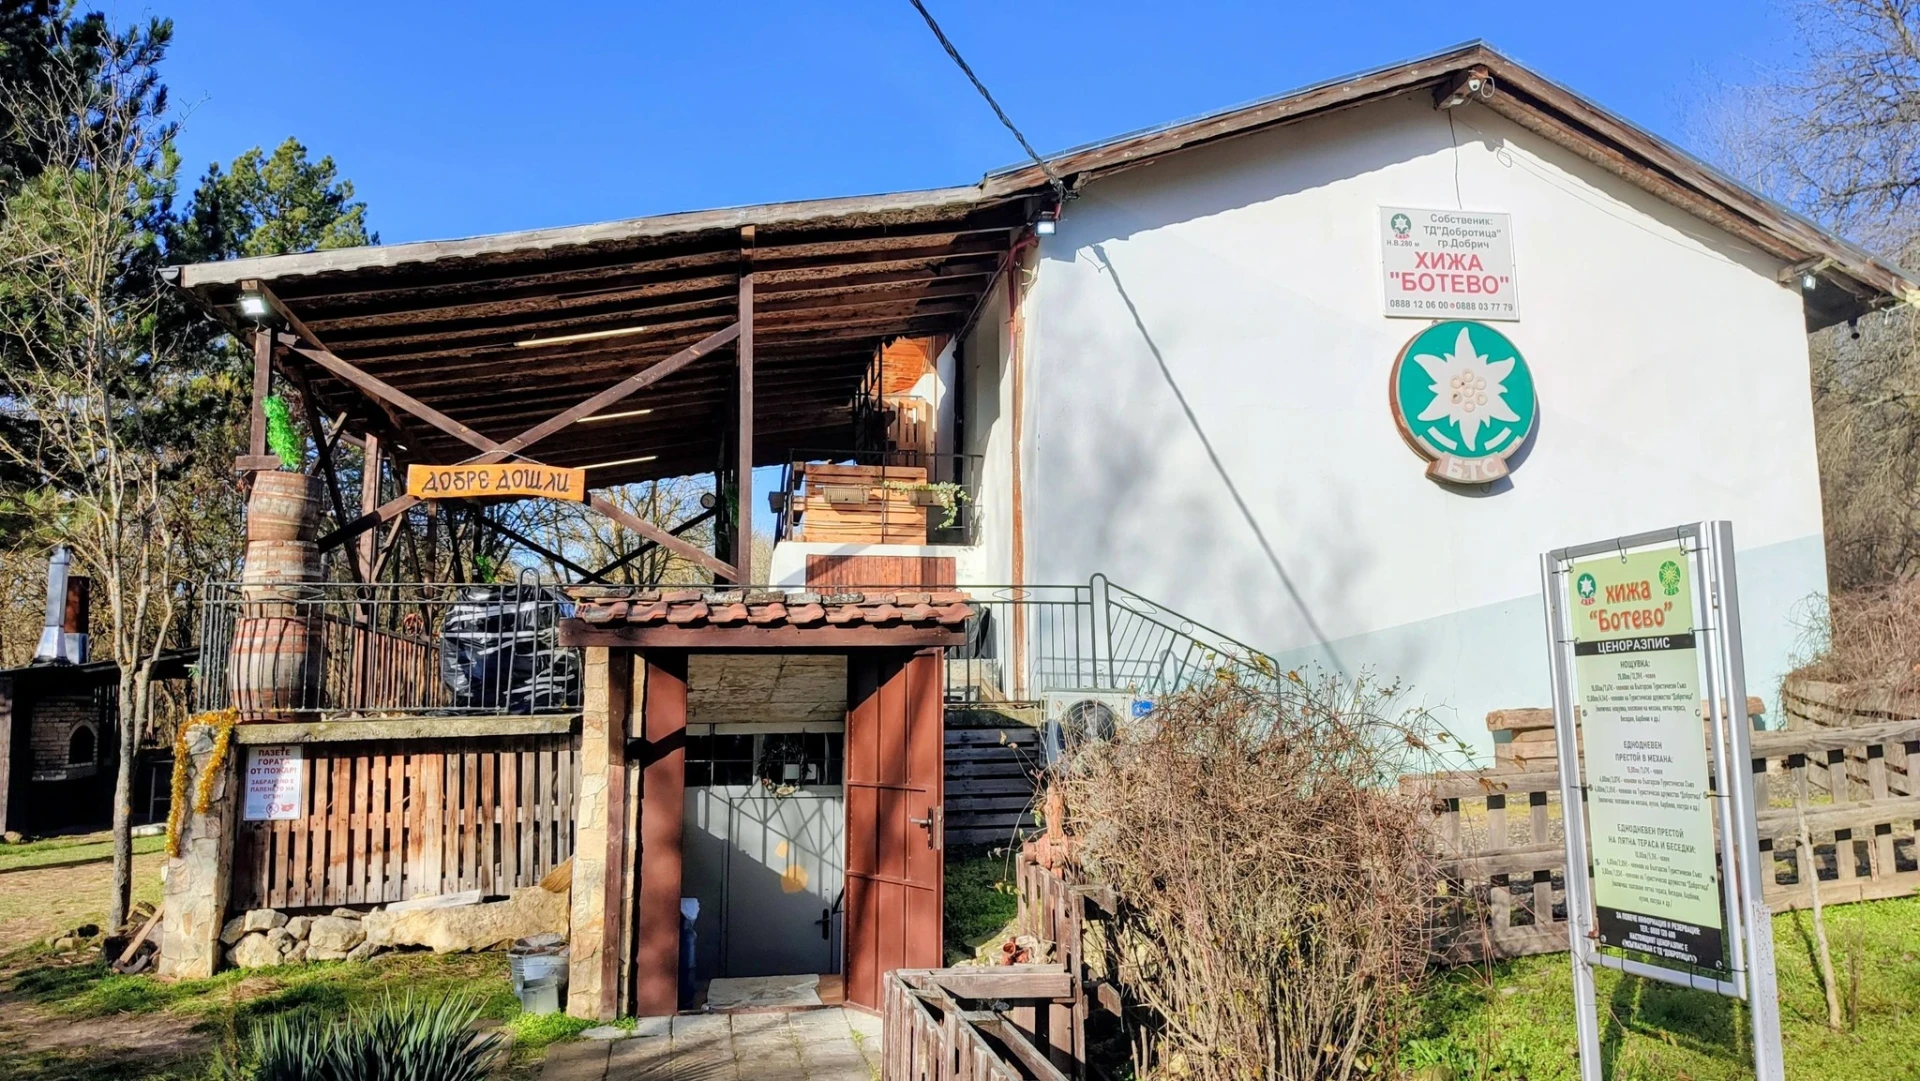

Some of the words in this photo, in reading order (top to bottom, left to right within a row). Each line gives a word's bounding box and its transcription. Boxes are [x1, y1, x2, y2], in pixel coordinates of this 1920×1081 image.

[1430, 213, 1494, 226] Собственик:
[1437, 239, 1490, 250] гр.Добрич
[1414, 251, 1484, 272] ХИЖА
[1389, 271, 1509, 295] "БОТЕВО"
[1389, 299, 1411, 309] 0888
[1413, 300, 1424, 309] 12
[1425, 300, 1436, 309] 06
[1438, 301, 1449, 310] 00
[1456, 301, 1476, 310] 0888
[1478, 302, 1489, 311] 03
[1490, 302, 1501, 311] 77
[1503, 303, 1513, 311] 79
[1446, 458, 1499, 480] БТС
[421, 470, 490, 493] ДОБРЕ
[495, 469, 570, 493] ДОШЛИ
[1605, 580, 1652, 604] хижа
[1598, 637, 1671, 654] ЦЕНОРАЗПИС
[1623, 741, 1662, 749] ЕДНОДНЕВЕН
[258, 749, 291, 757] ПАЗЕТЕ
[1615, 752, 1641, 762] ПРЕСТОЙ
[1642, 754, 1646, 762] В
[258, 758, 290, 766] ГОРАТА
[1617, 823, 1656, 835] ЕДНОДНЕВЕН
[1657, 827, 1684, 839] ПРЕСТОЙ
[1608, 835, 1616, 844] НА
[1637, 838, 1660, 849] ТЕРАСА
[1661, 841, 1666, 850] И
